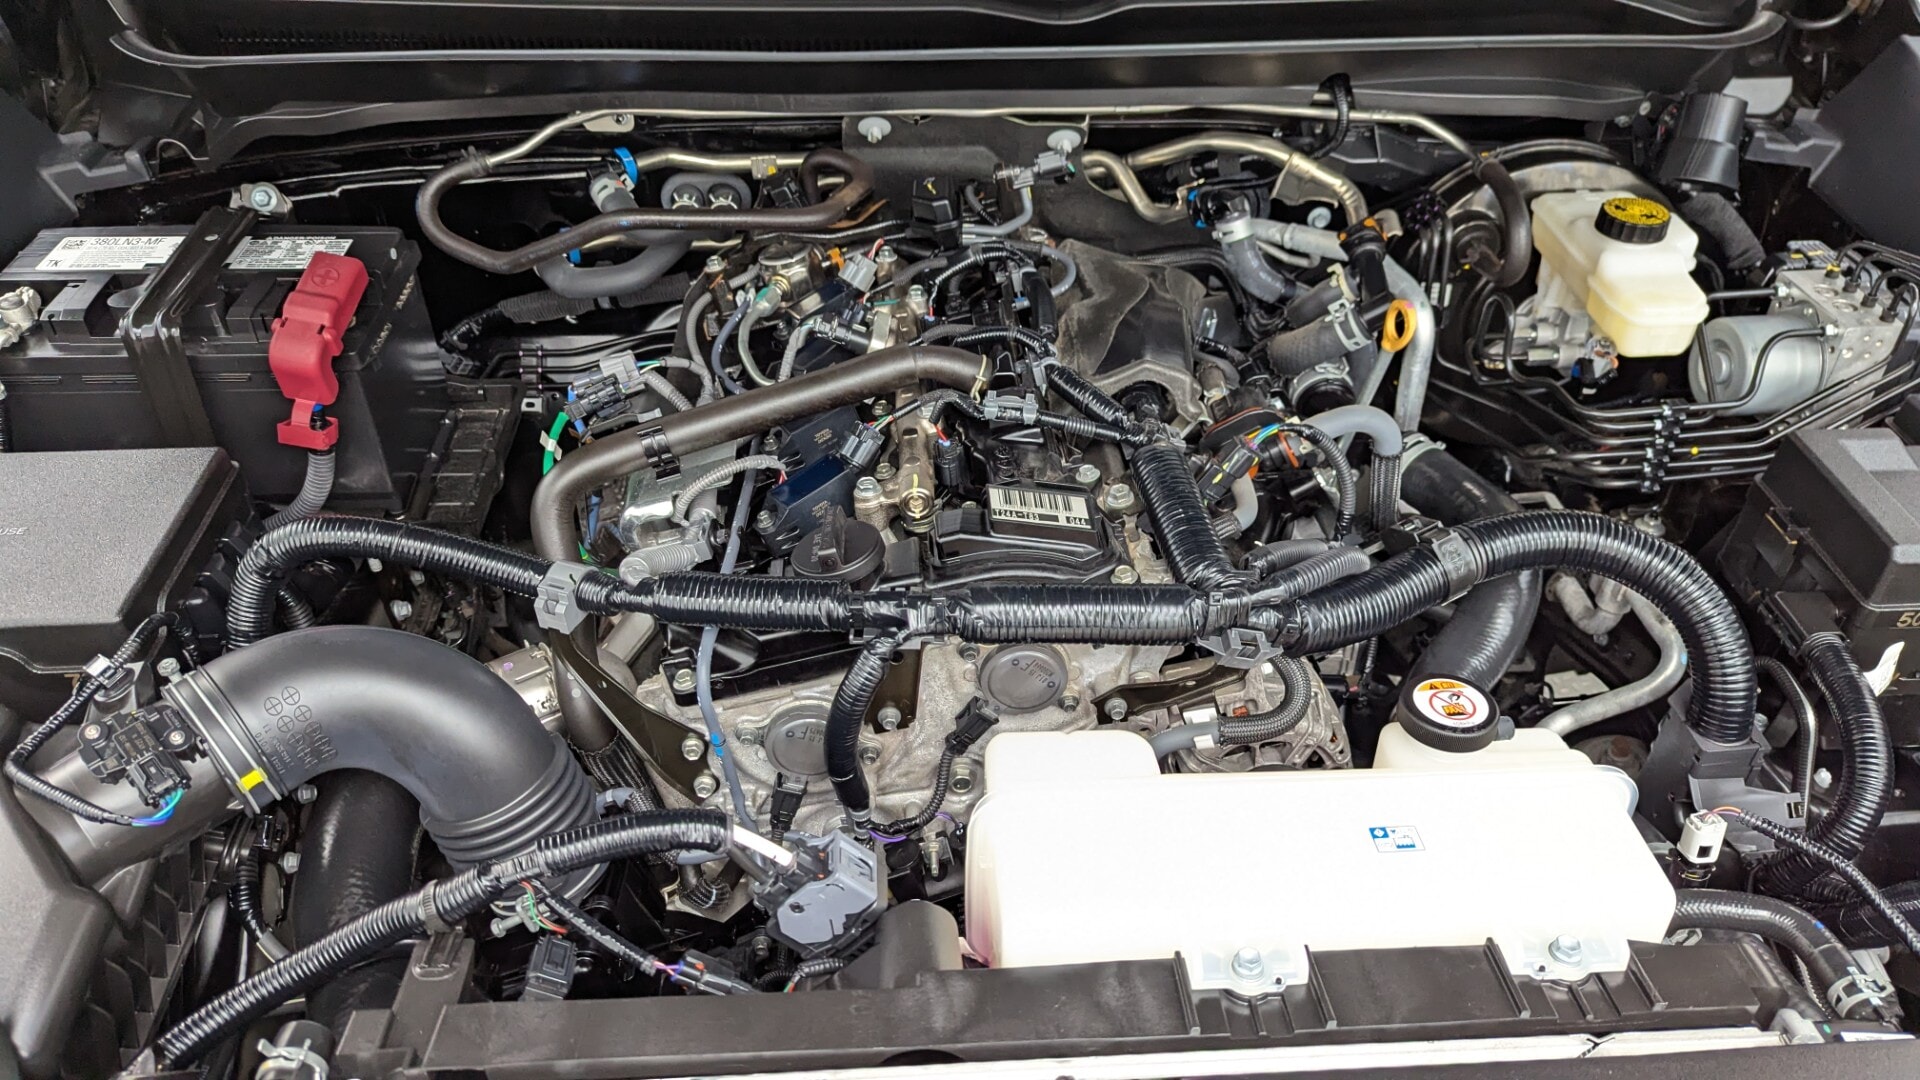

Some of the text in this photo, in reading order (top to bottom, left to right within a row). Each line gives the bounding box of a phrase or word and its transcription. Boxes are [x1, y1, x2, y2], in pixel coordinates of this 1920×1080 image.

[90, 238, 167, 246] 380LN3-MF
[45, 259, 62, 268] TK
[1069, 517, 1087, 526] 044
